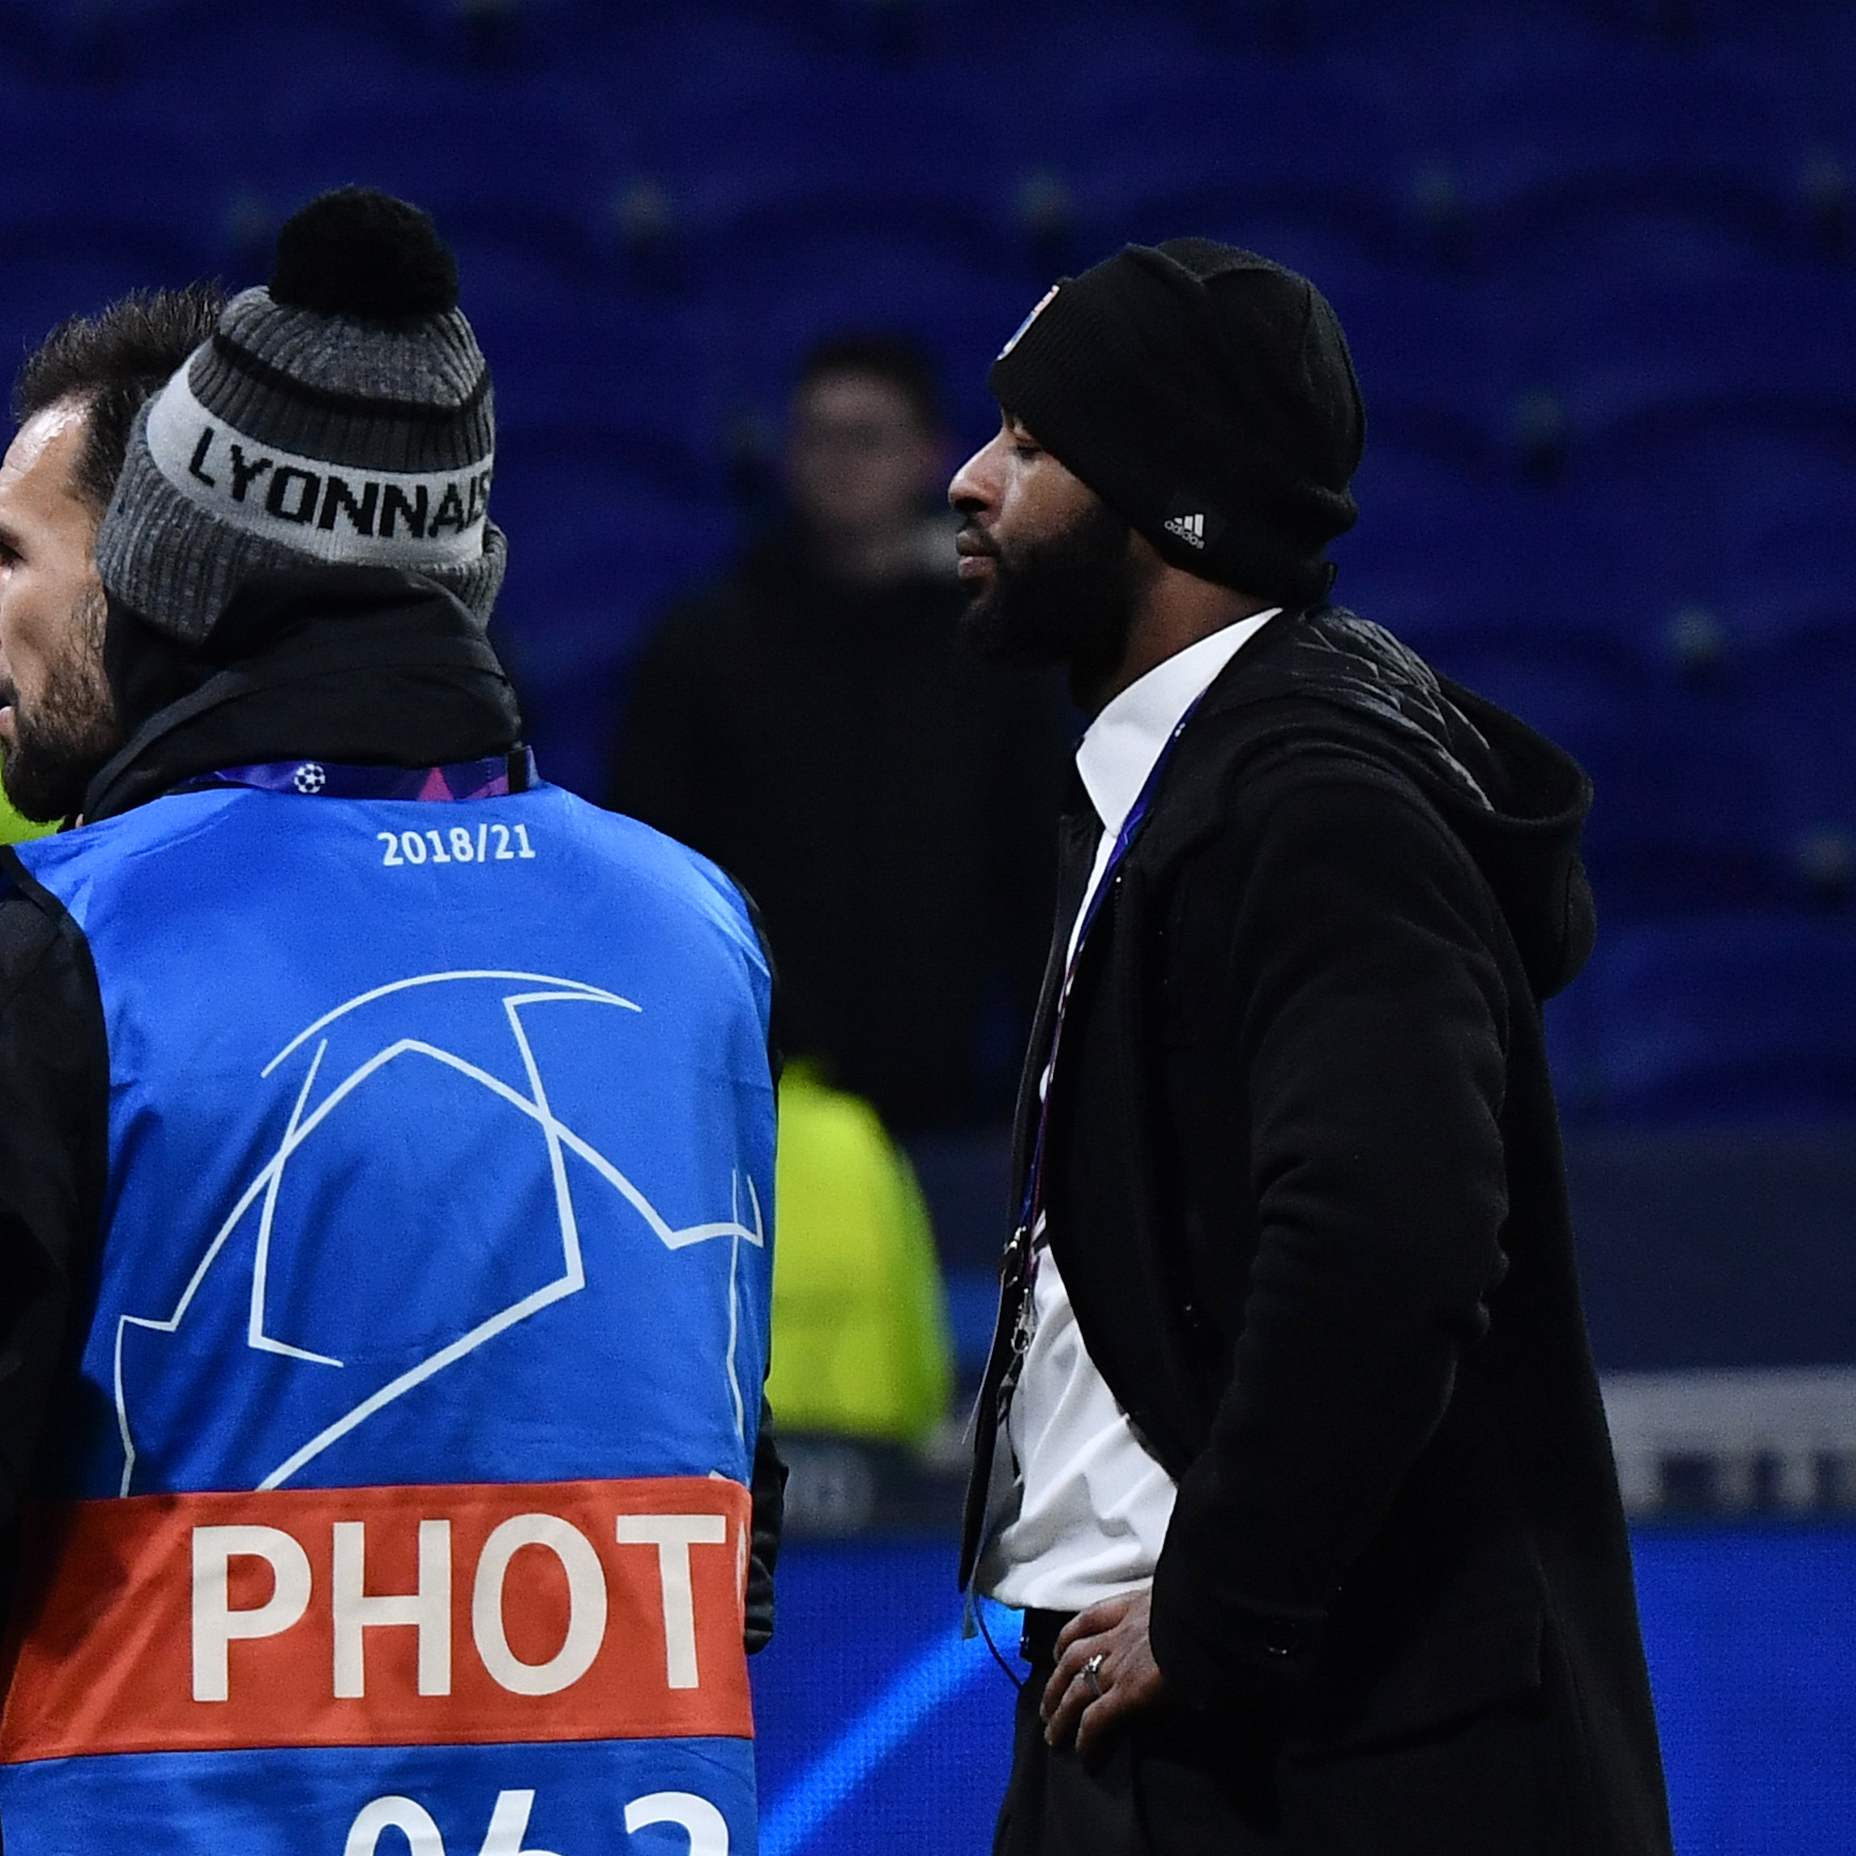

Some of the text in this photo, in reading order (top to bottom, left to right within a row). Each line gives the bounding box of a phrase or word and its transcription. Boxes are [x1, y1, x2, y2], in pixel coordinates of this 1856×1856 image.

[1164, 520, 1205, 550] adidas
[376, 823, 536, 867] 2018/21
[192, 1513, 748, 1702] PHOT
